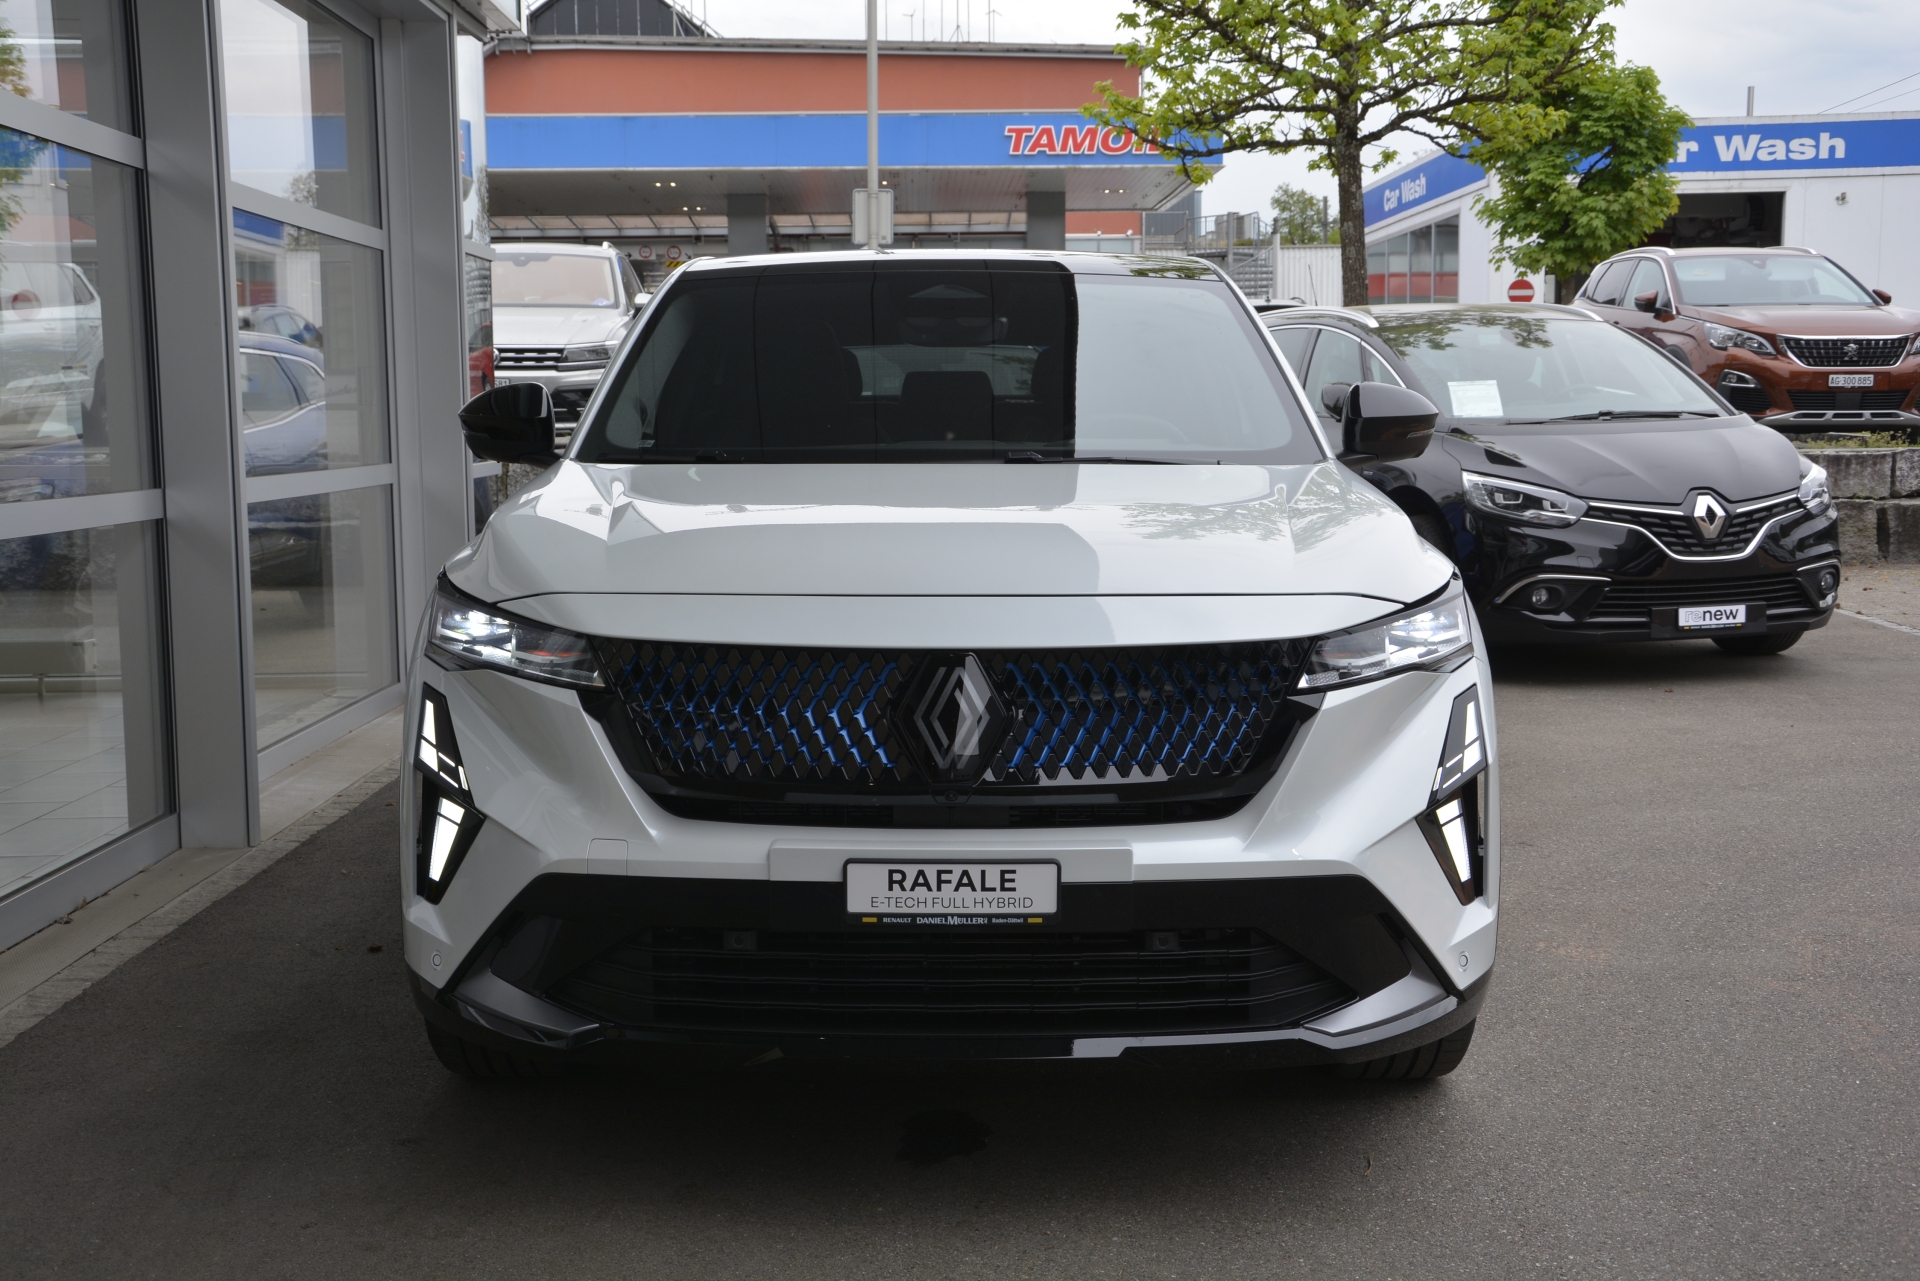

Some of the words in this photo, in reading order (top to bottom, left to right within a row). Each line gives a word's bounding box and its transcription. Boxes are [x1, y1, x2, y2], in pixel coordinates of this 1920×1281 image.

[1713, 132, 1846, 162] Wash
[1384, 189, 1400, 211] Car
[1401, 173, 1426, 204] Wash
[1685, 608, 1739, 623] renew
[887, 869, 1017, 892] RAFALE
[870, 896, 927, 909] E-TECH
[932, 897, 969, 909] FULL
[973, 897, 1034, 909] HYBRID
